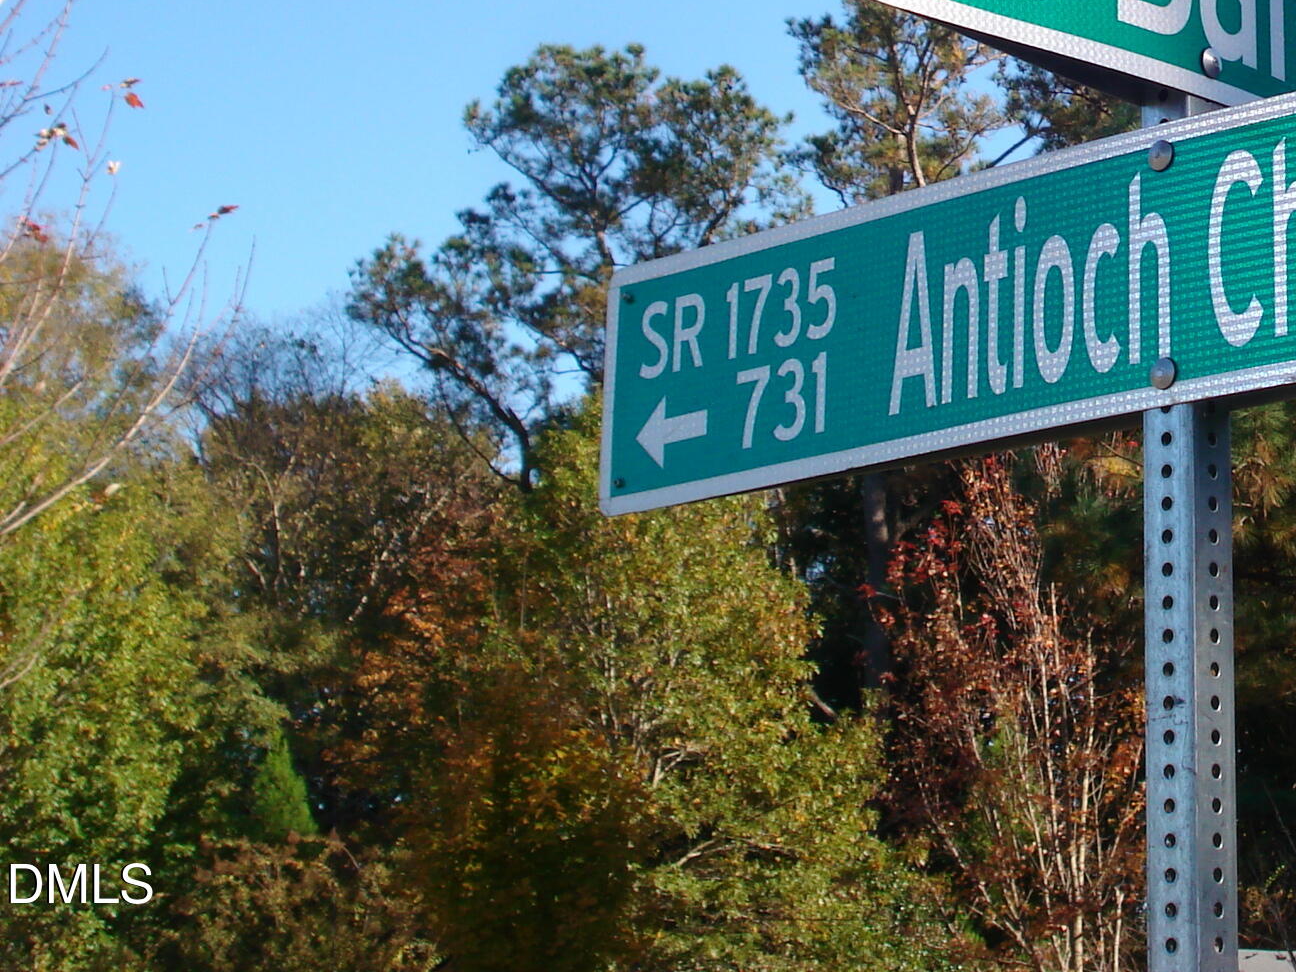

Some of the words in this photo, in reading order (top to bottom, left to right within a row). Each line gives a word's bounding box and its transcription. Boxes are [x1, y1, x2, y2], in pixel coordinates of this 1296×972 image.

[639, 293, 706, 380] SR
[726, 257, 837, 360] 1735
[888, 172, 1172, 416] Antioch
[736, 351, 828, 449] 731
